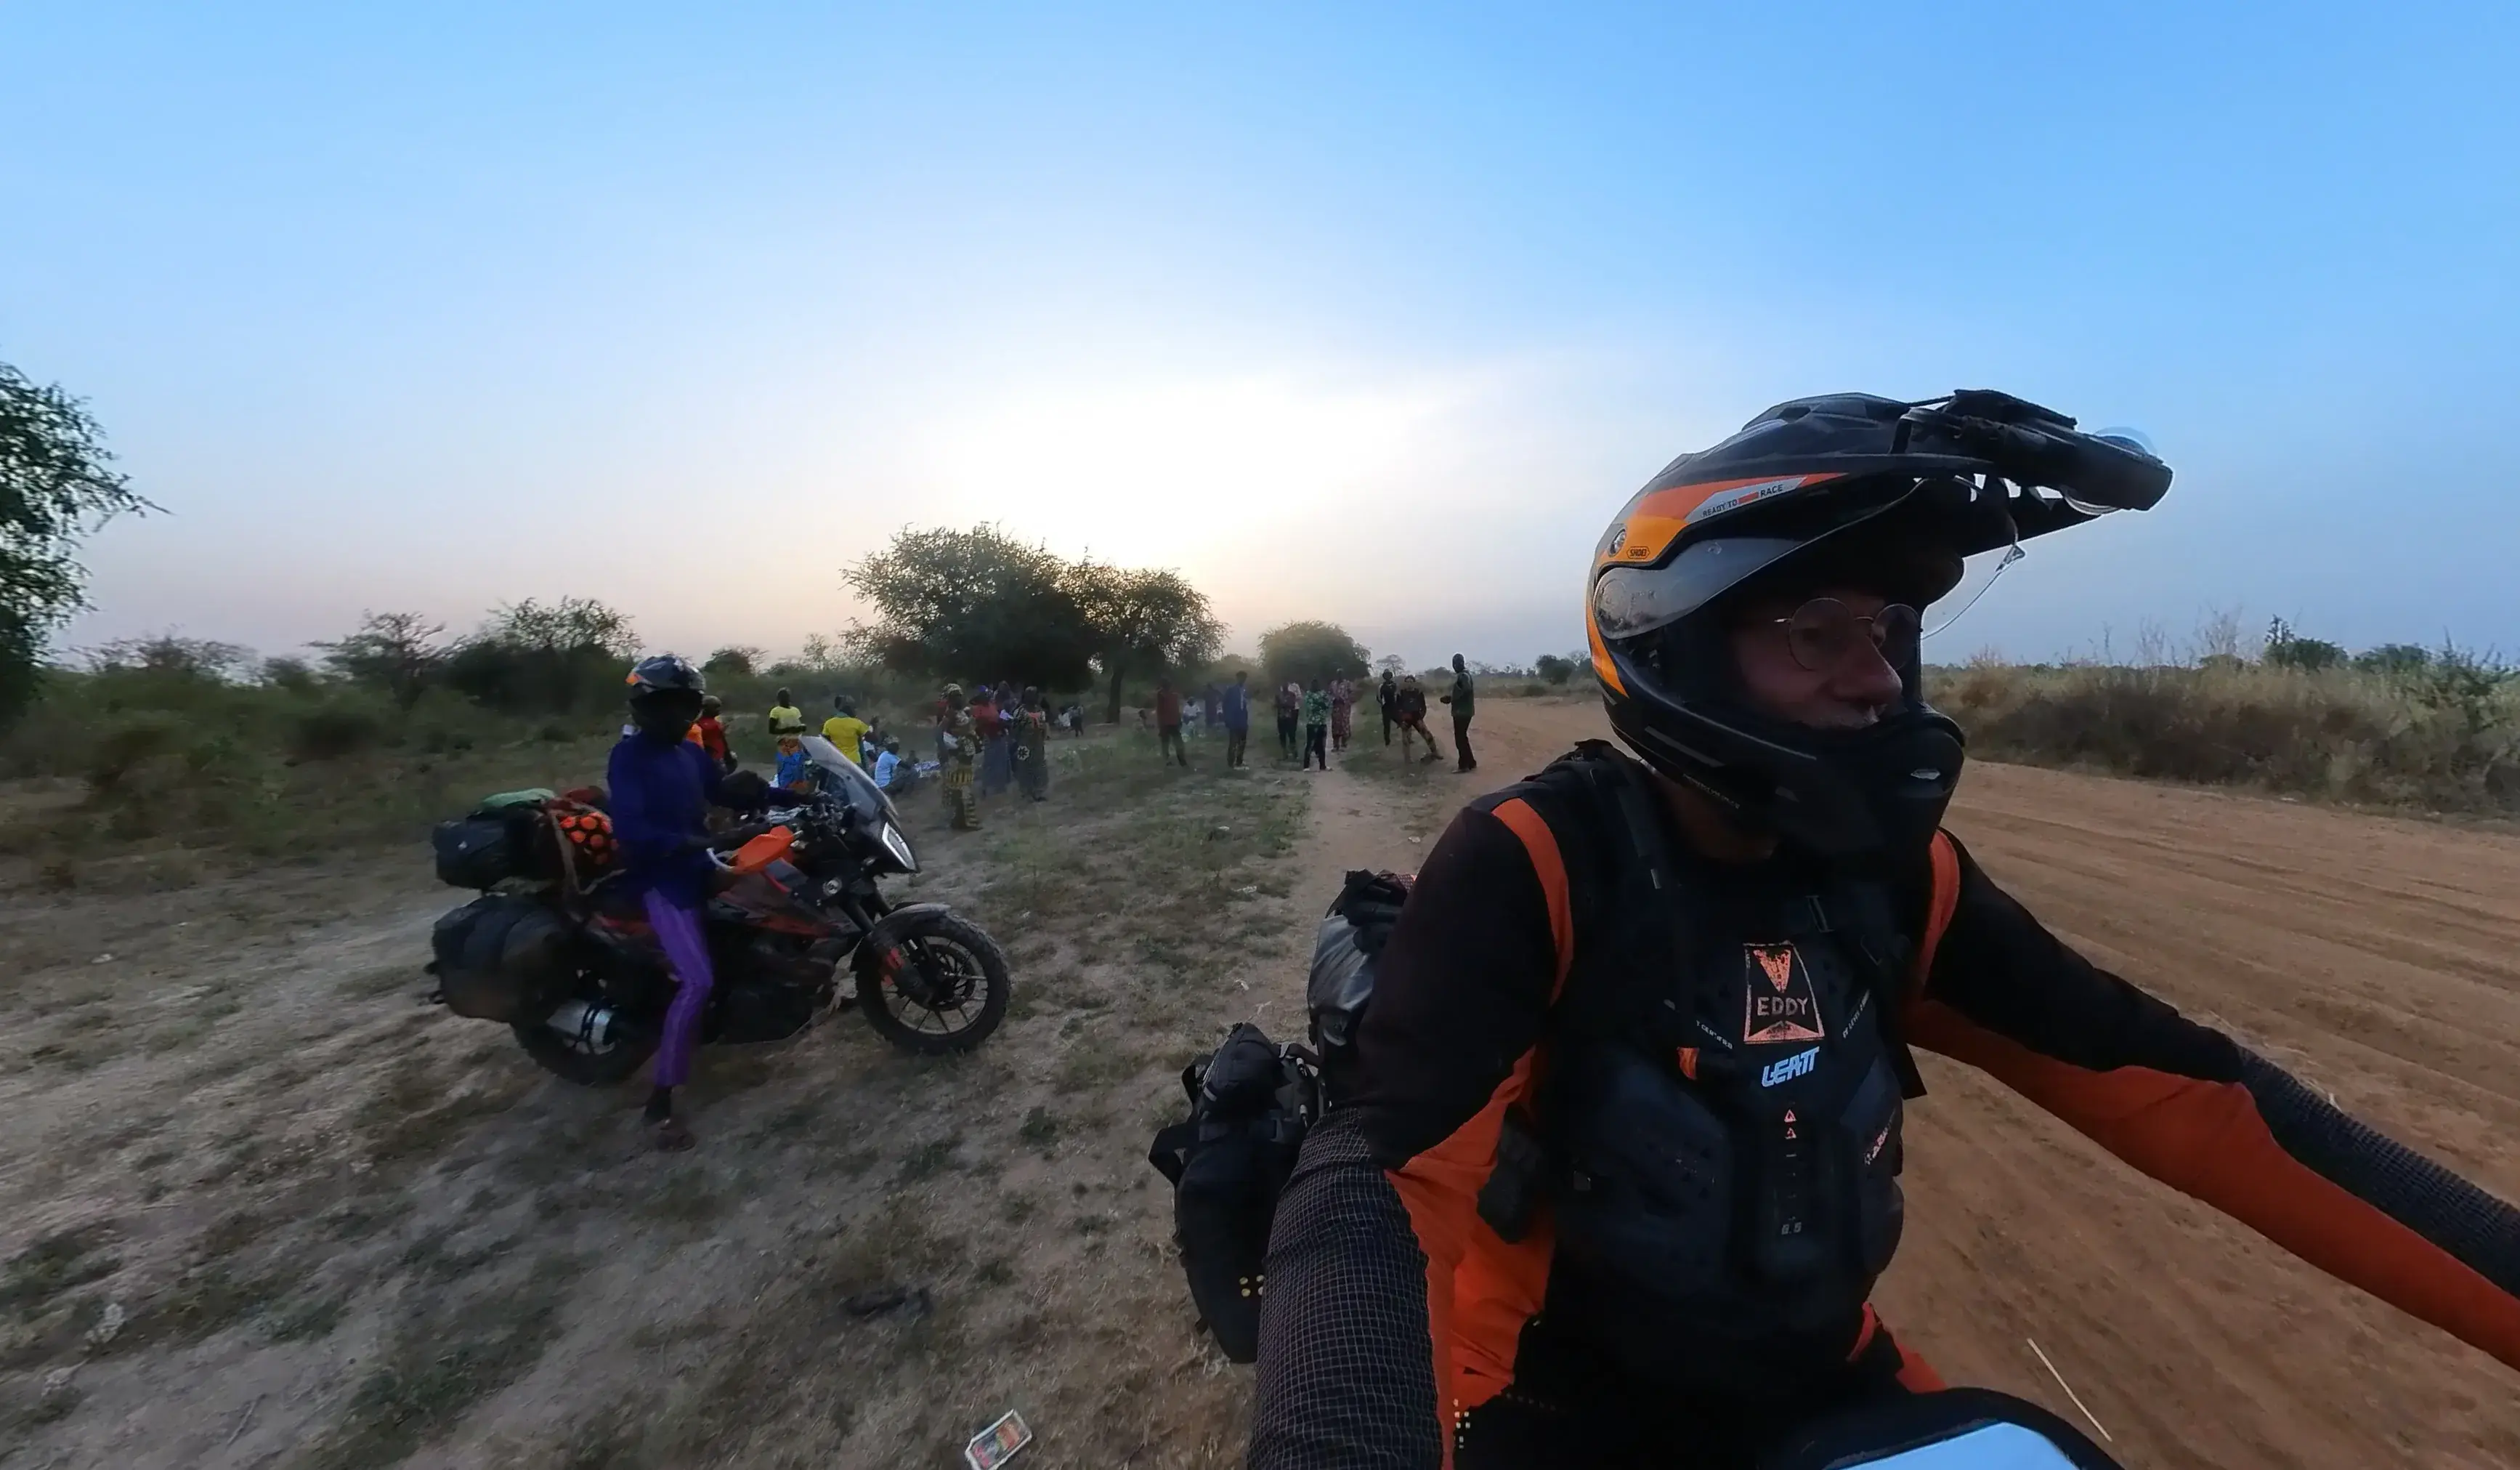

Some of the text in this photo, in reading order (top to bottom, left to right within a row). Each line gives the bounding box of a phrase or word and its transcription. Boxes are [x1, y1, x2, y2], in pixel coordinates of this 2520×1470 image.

[1702, 504, 1725, 517] READY
[1760, 484, 1783, 498] RACE
[1757, 996, 1808, 1016] EDDY
[1762, 1046, 1820, 1087] LEATT
